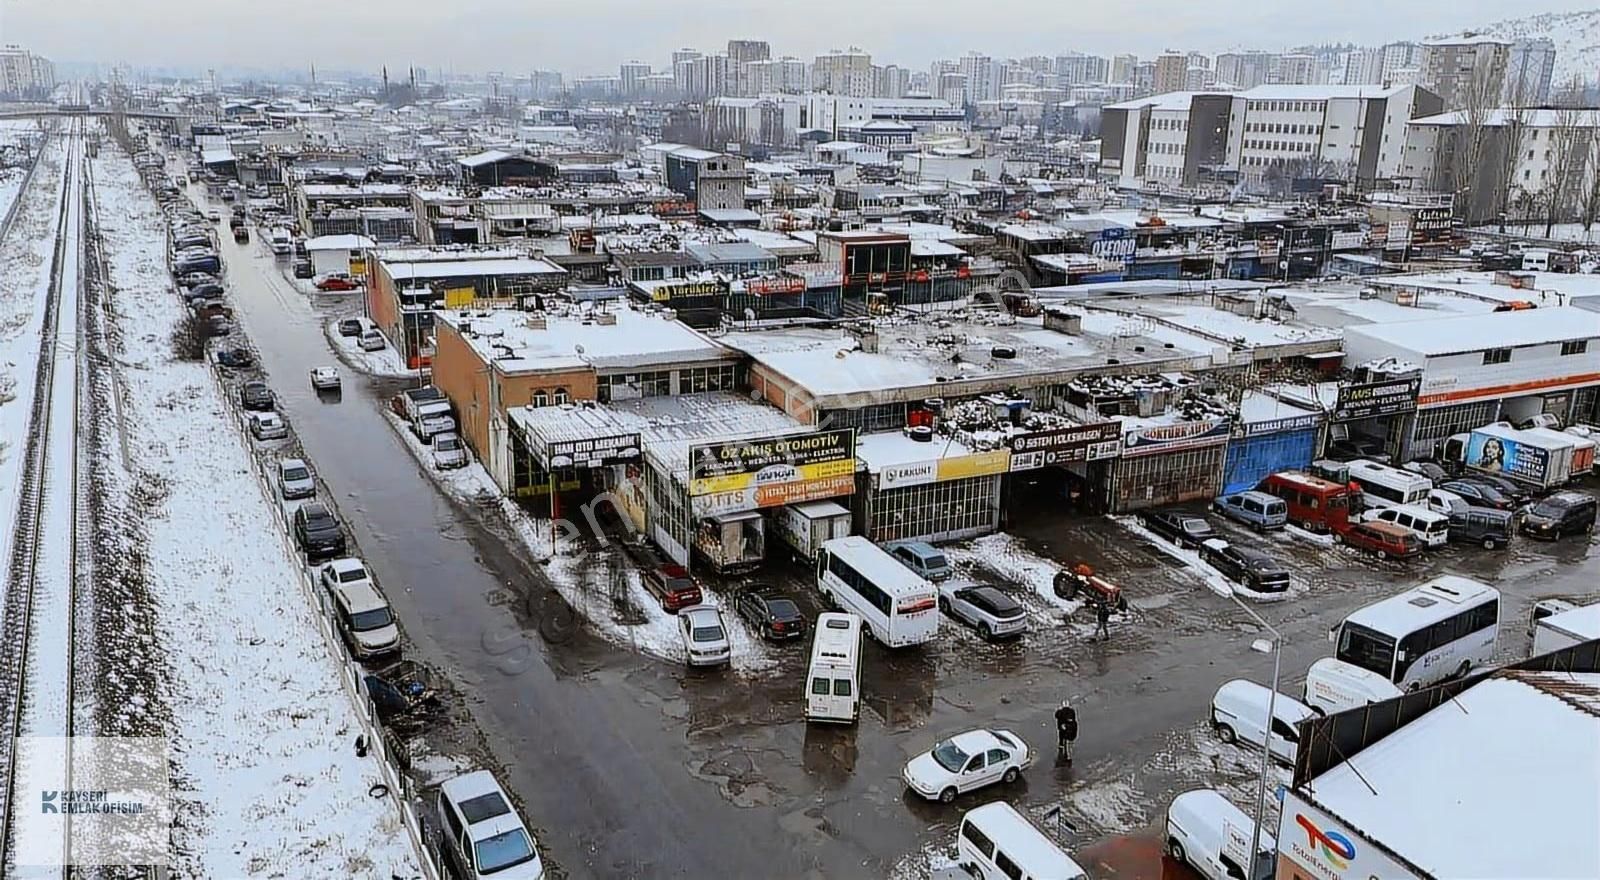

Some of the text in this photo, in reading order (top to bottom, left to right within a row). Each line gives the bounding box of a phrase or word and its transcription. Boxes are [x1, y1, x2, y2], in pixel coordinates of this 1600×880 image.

[1092, 239, 1136, 256] OXFORD
[575, 440, 593, 452] OTO
[720, 433, 840, 459] ÖZ AKIŞ OTOMOTİV
